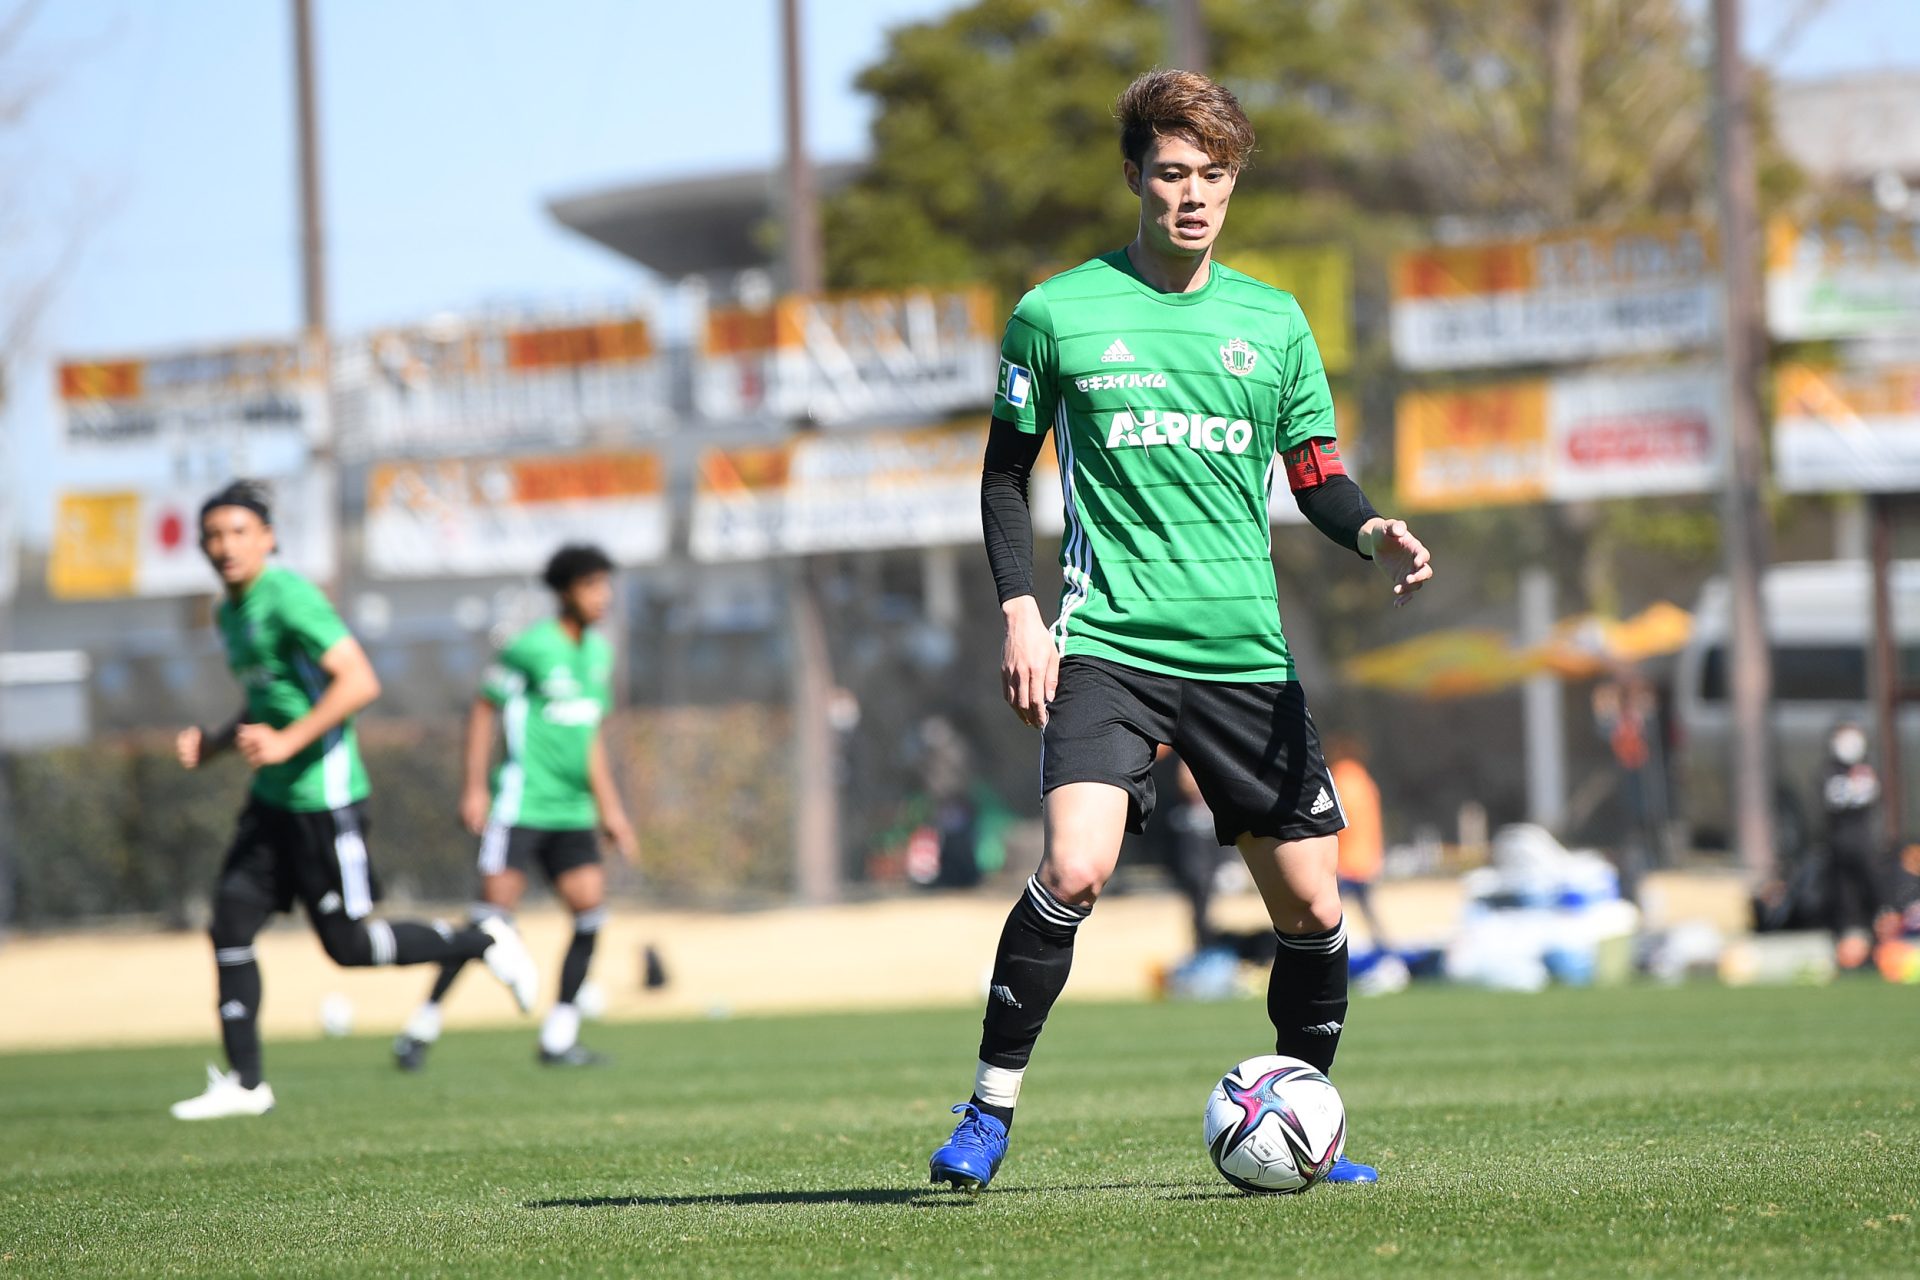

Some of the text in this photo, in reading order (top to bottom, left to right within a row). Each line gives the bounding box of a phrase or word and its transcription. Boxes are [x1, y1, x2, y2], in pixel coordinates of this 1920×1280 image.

[1101, 353, 1136, 363] adidas
[1075, 373, 1167, 392] セキスイハイム
[1106, 403, 1253, 456] ALPICO
